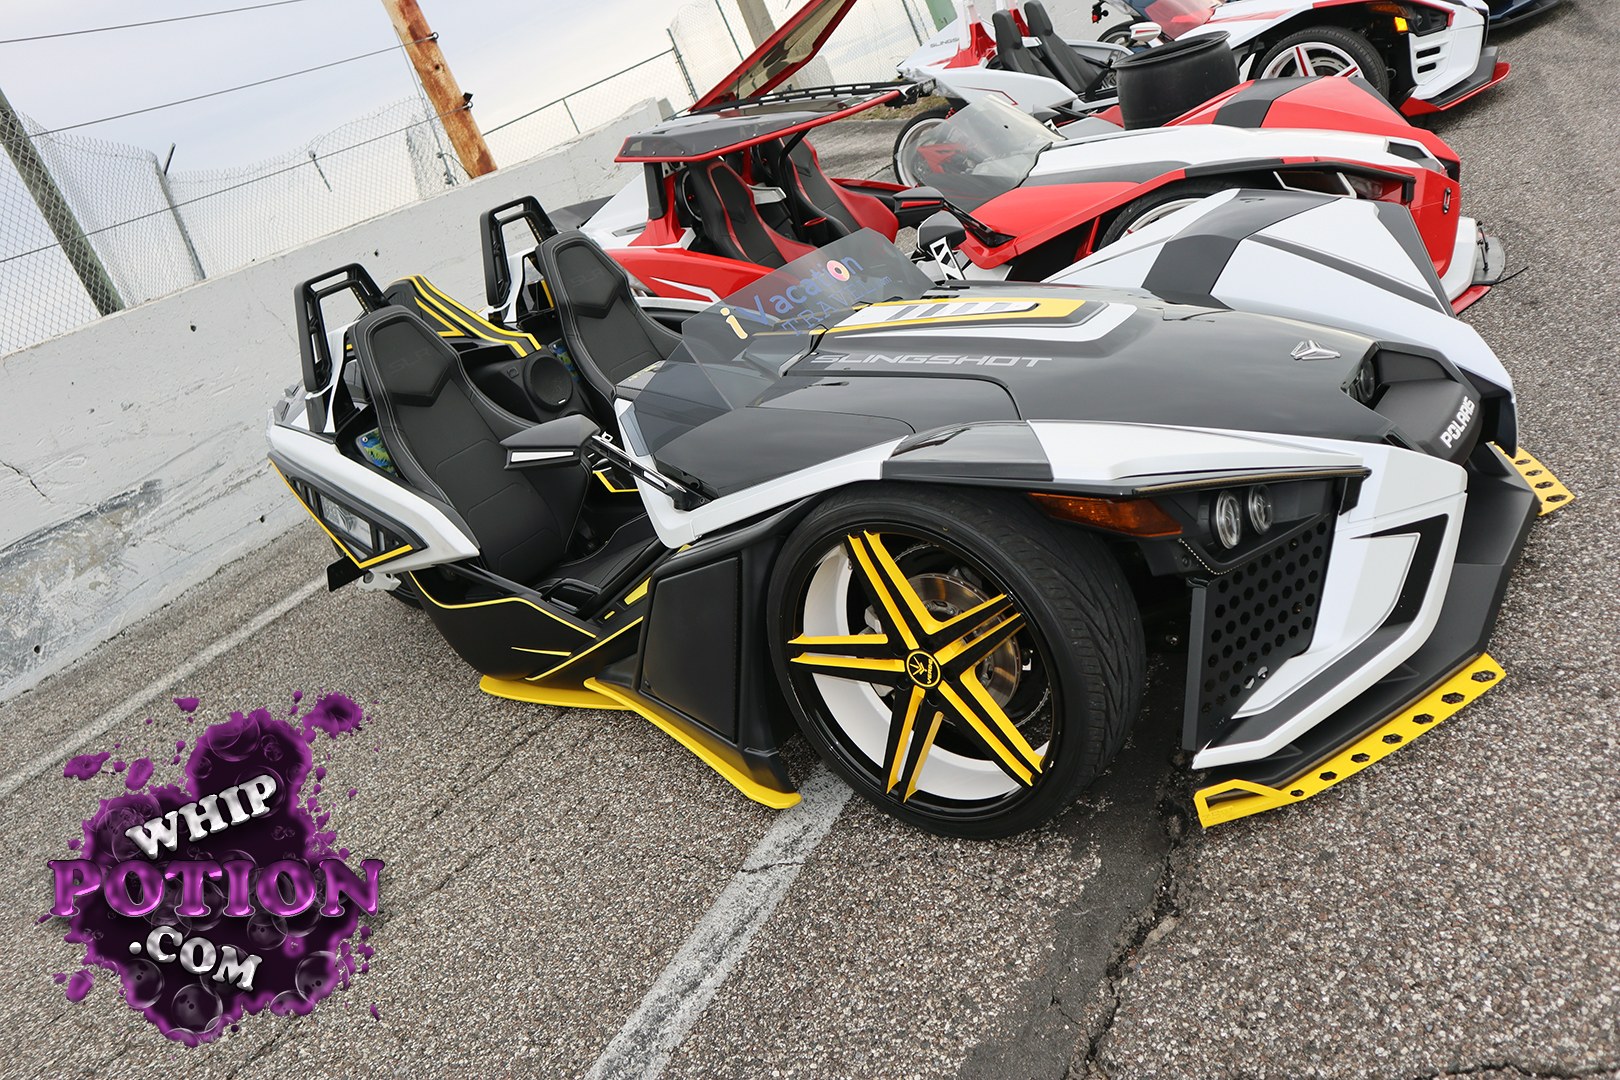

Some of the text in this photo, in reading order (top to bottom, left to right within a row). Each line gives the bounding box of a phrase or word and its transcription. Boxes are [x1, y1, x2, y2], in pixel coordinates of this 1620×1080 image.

[720, 256, 864, 339] i Vacation
[781, 276, 876, 336] TRAVEL
[810, 353, 1053, 368] SLINGSHOT
[1440, 395, 1475, 448] POLARIS
